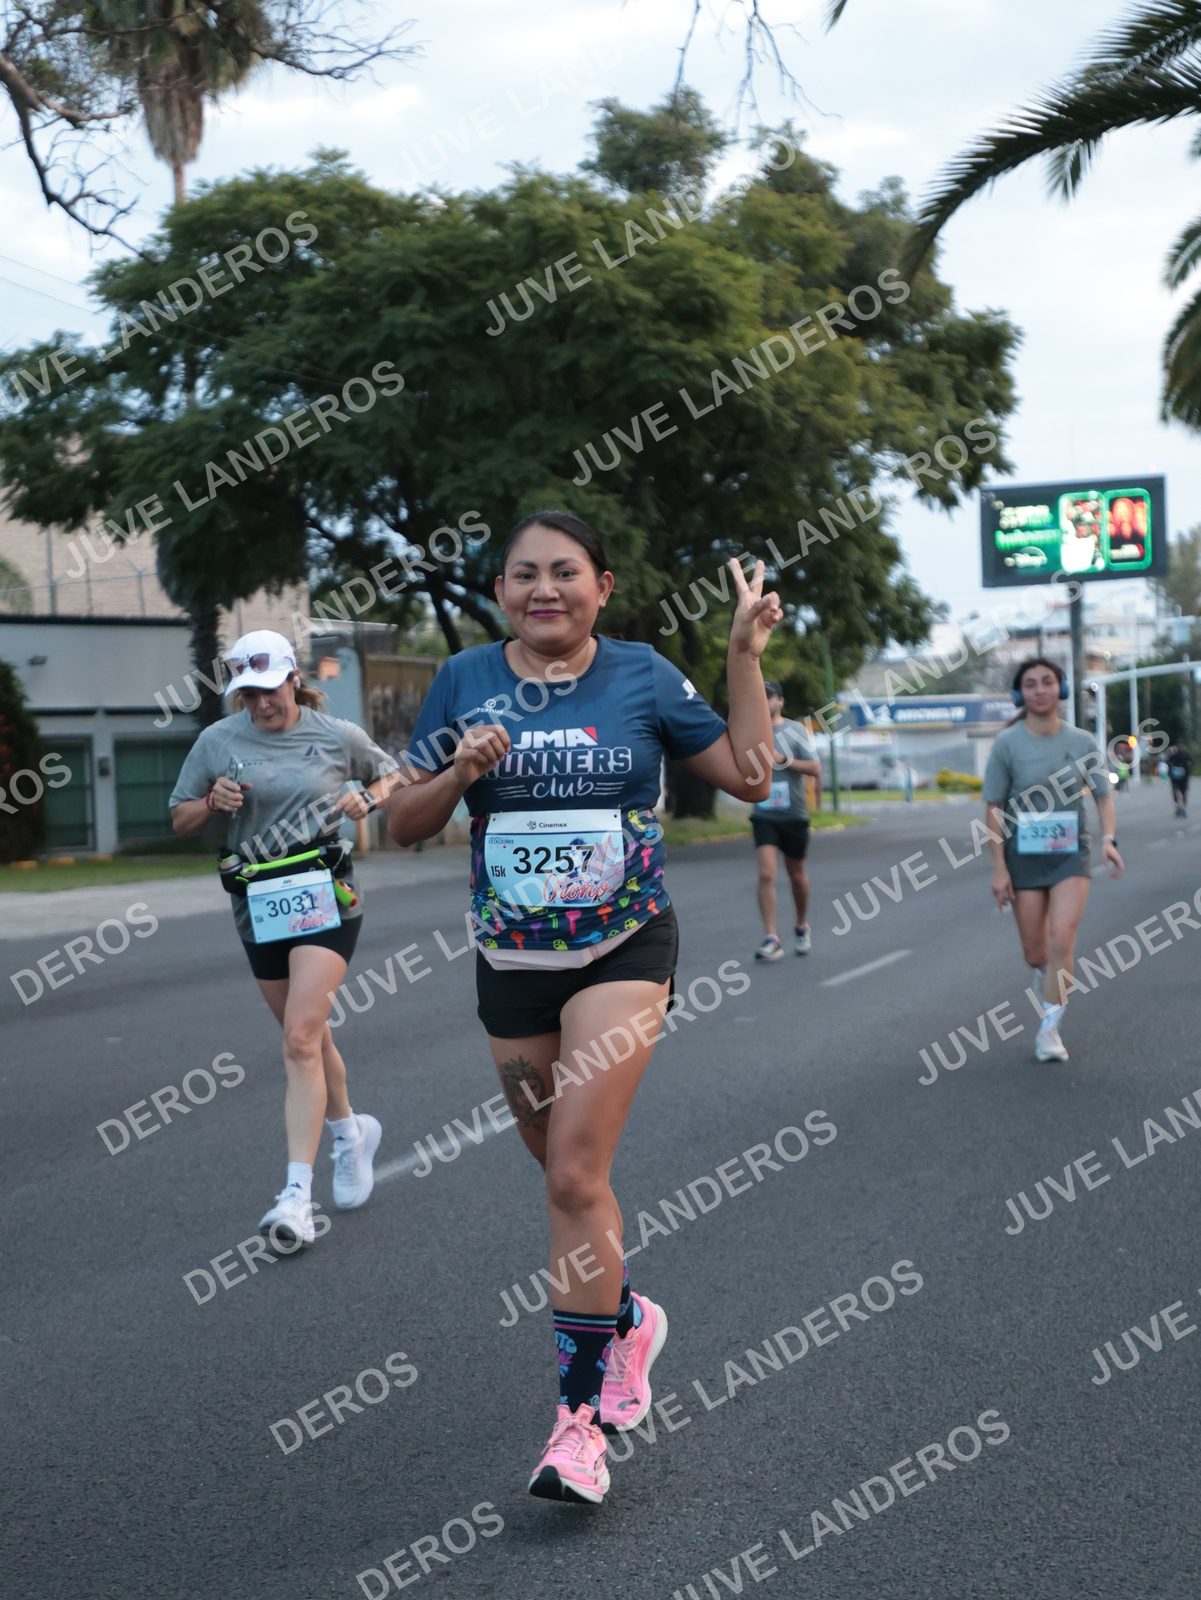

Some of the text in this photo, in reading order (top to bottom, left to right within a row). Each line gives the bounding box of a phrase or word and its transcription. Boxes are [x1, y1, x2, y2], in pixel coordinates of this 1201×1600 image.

[513, 727, 598, 749] JMA
[532, 777, 595, 798] club
[512, 846, 595, 874] 3257
[490, 865, 506, 878] 15k
[266, 893, 319, 918] 3031
